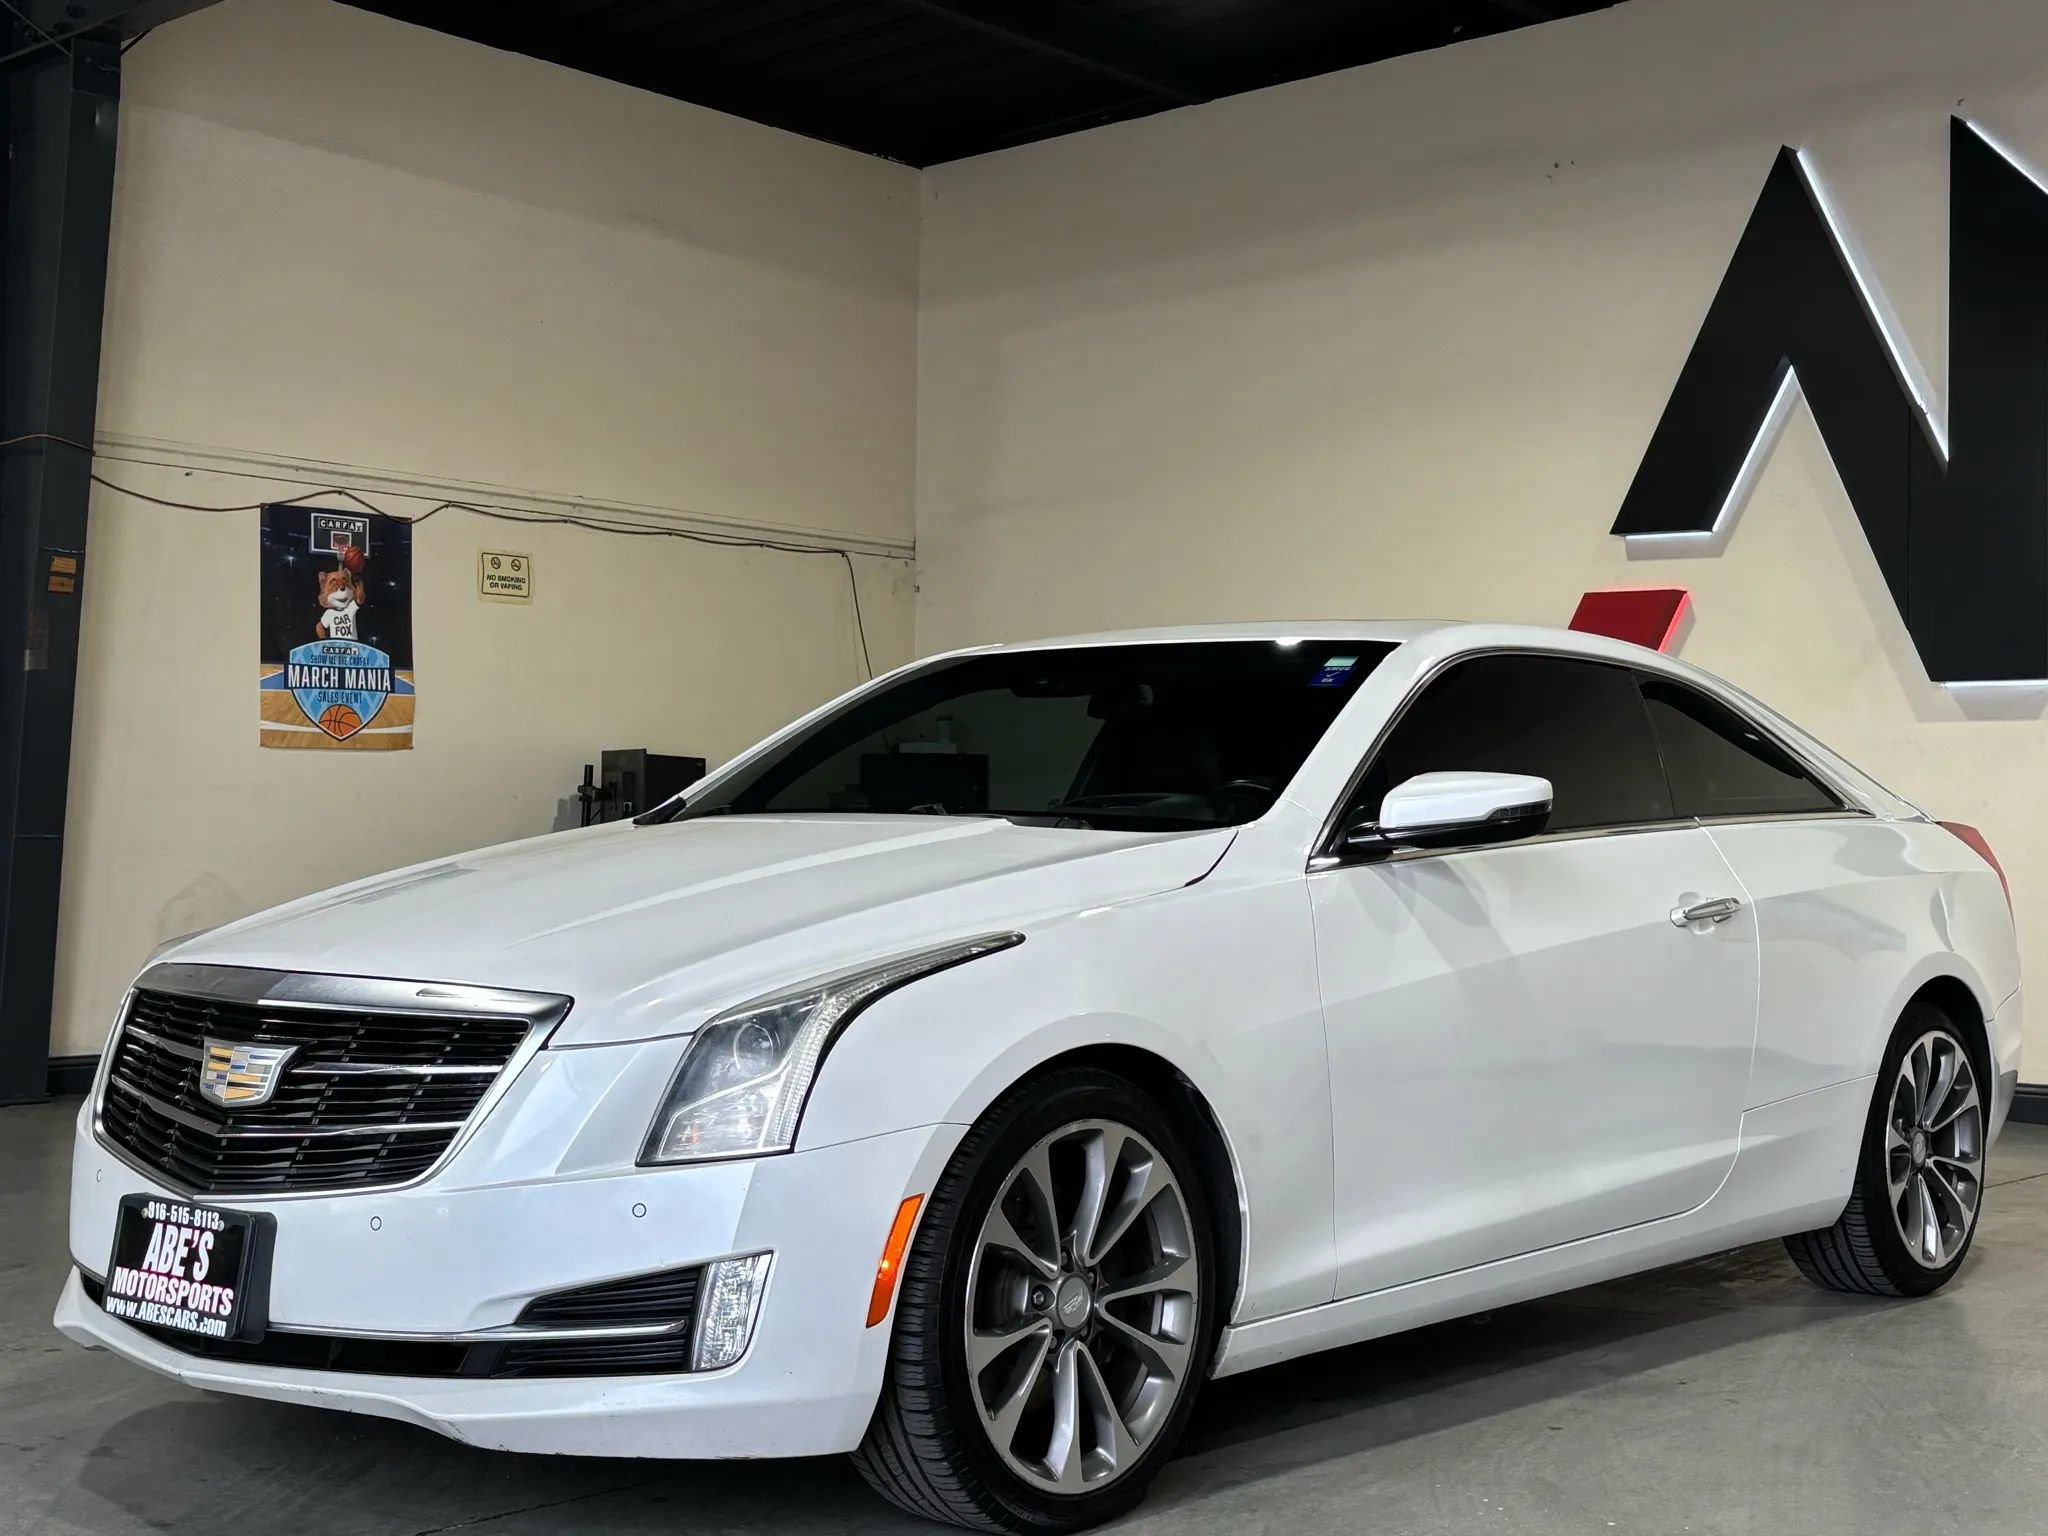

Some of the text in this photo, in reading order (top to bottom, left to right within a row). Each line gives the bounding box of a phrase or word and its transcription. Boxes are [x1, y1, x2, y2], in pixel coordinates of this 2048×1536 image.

[320, 518, 363, 532] CARFAX
[497, 575, 526, 584] SMOKING
[501, 583, 522, 591] VAPING
[333, 614, 351, 625] CAR
[335, 624, 352, 636] FOX
[323, 646, 359, 656] CARFAX
[310, 654, 327, 664] SHOW
[288, 665, 391, 691] MARCH MANIA
[318, 691, 362, 704] SALES EVENT
[148, 1201, 219, 1230] 916-515-8113
[142, 1223, 214, 1281] ABE'S
[112, 1267, 234, 1316] MOTORSPORTS
